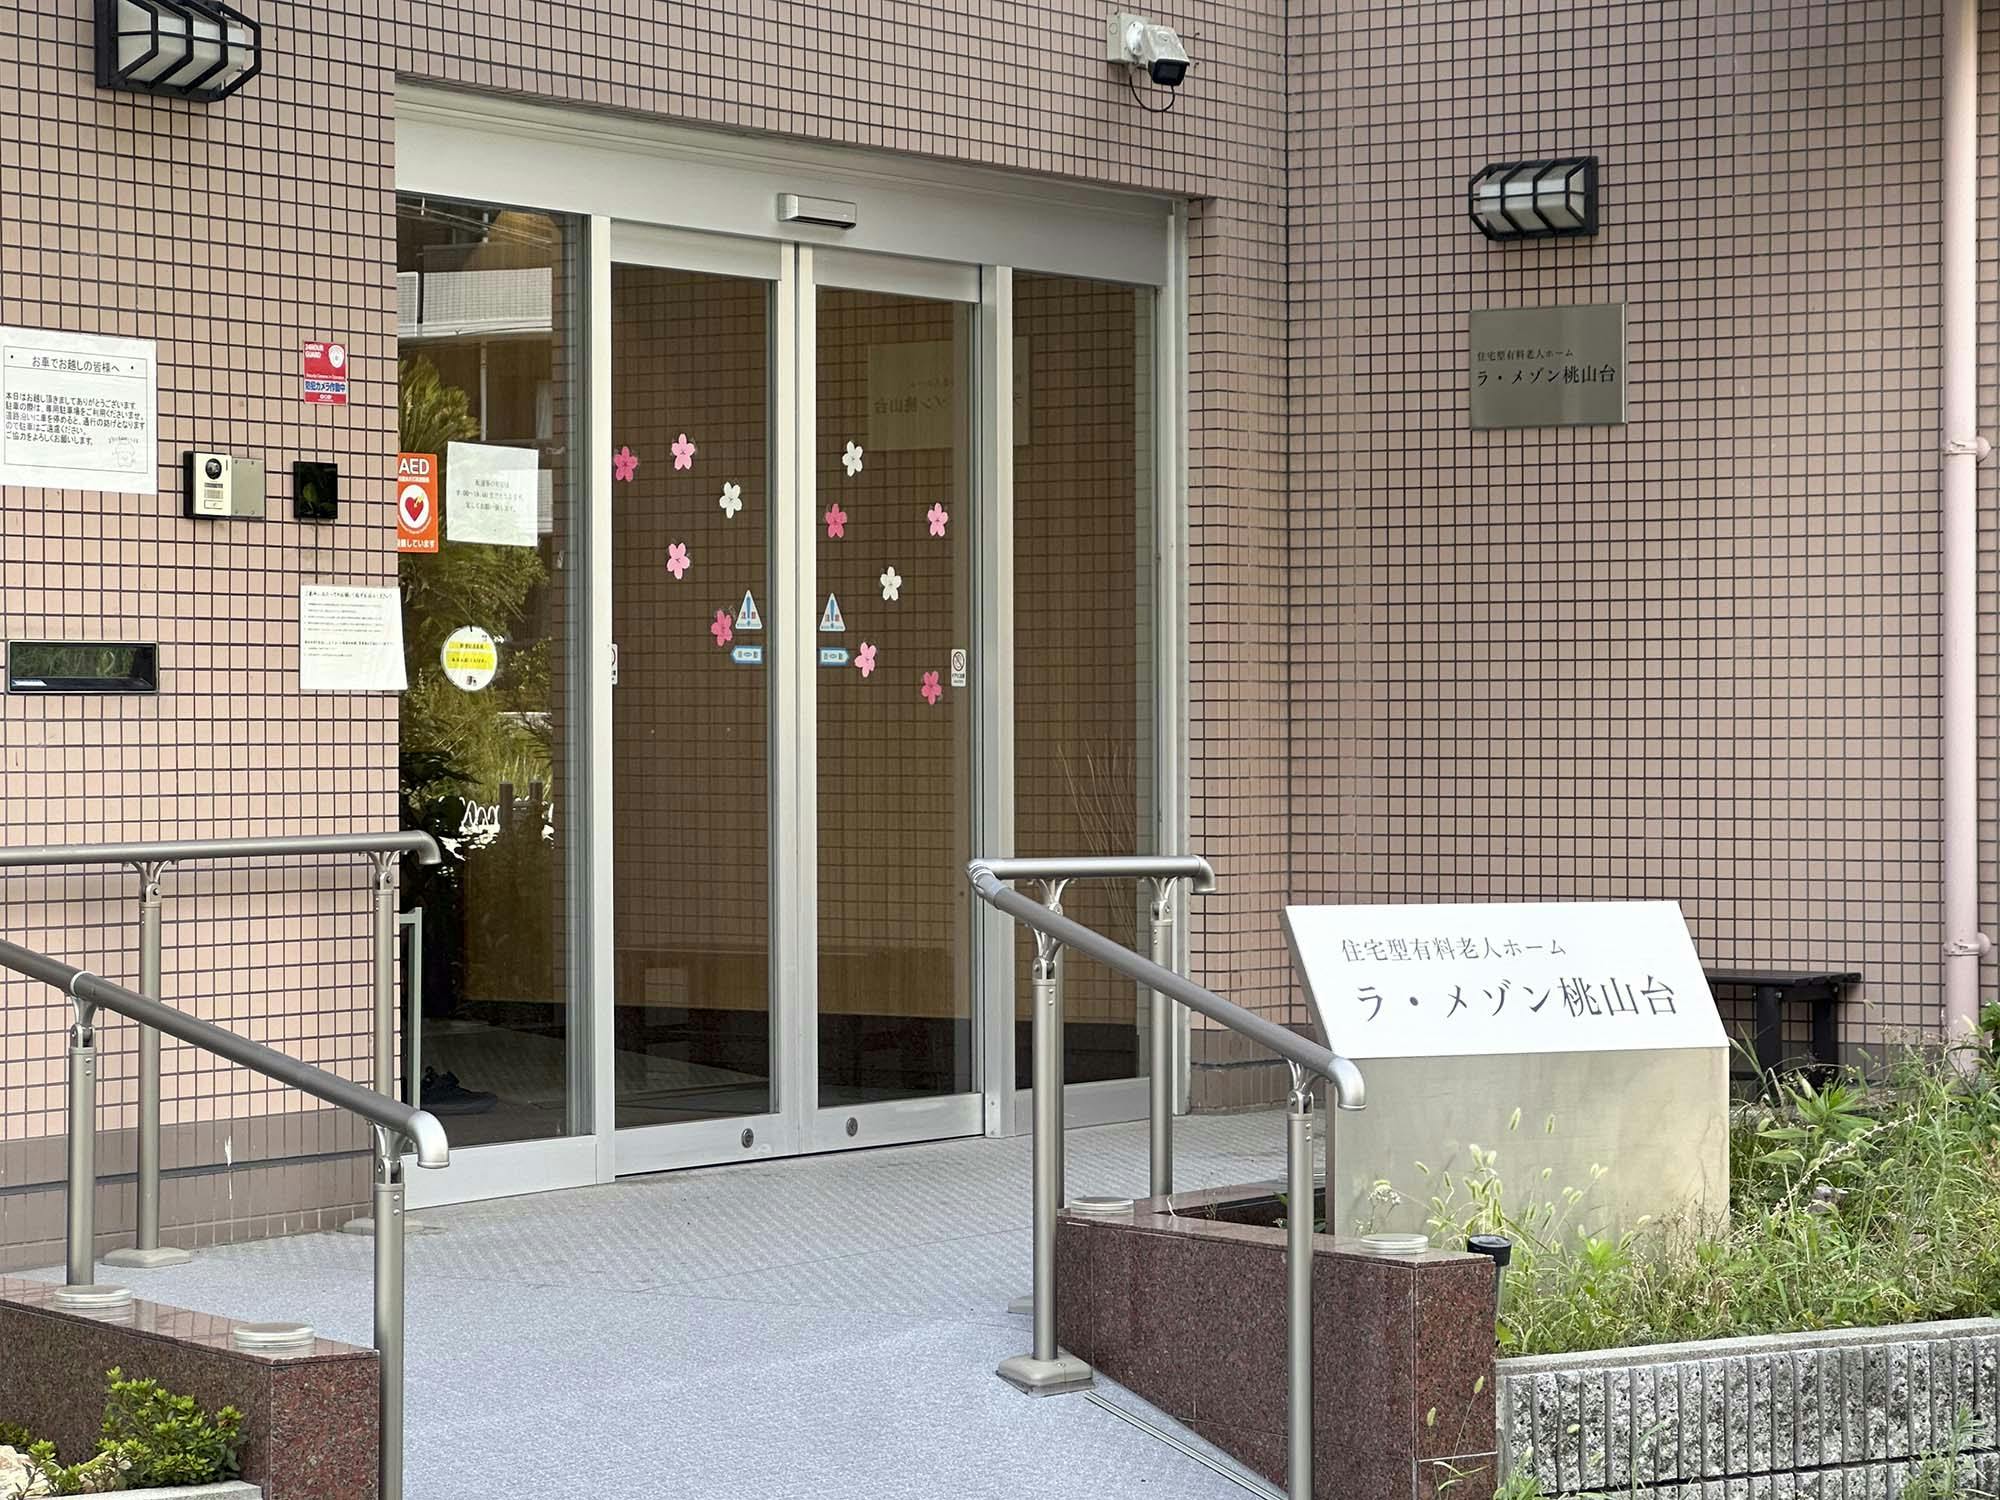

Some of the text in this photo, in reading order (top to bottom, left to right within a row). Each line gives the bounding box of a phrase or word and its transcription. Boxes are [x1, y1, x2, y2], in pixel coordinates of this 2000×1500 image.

[32, 356, 120, 373] お車でお越しの皆様へ
[1477, 348, 1573, 361] 住宅型有料老人ホーム
[1477, 364, 1616, 387] ラ・メゾン桃山台
[399, 458, 430, 475] AED
[1342, 937, 1567, 962] 住宅型有料老人ホーム
[1357, 975, 1676, 1022] ラ・メゾン桃山台
